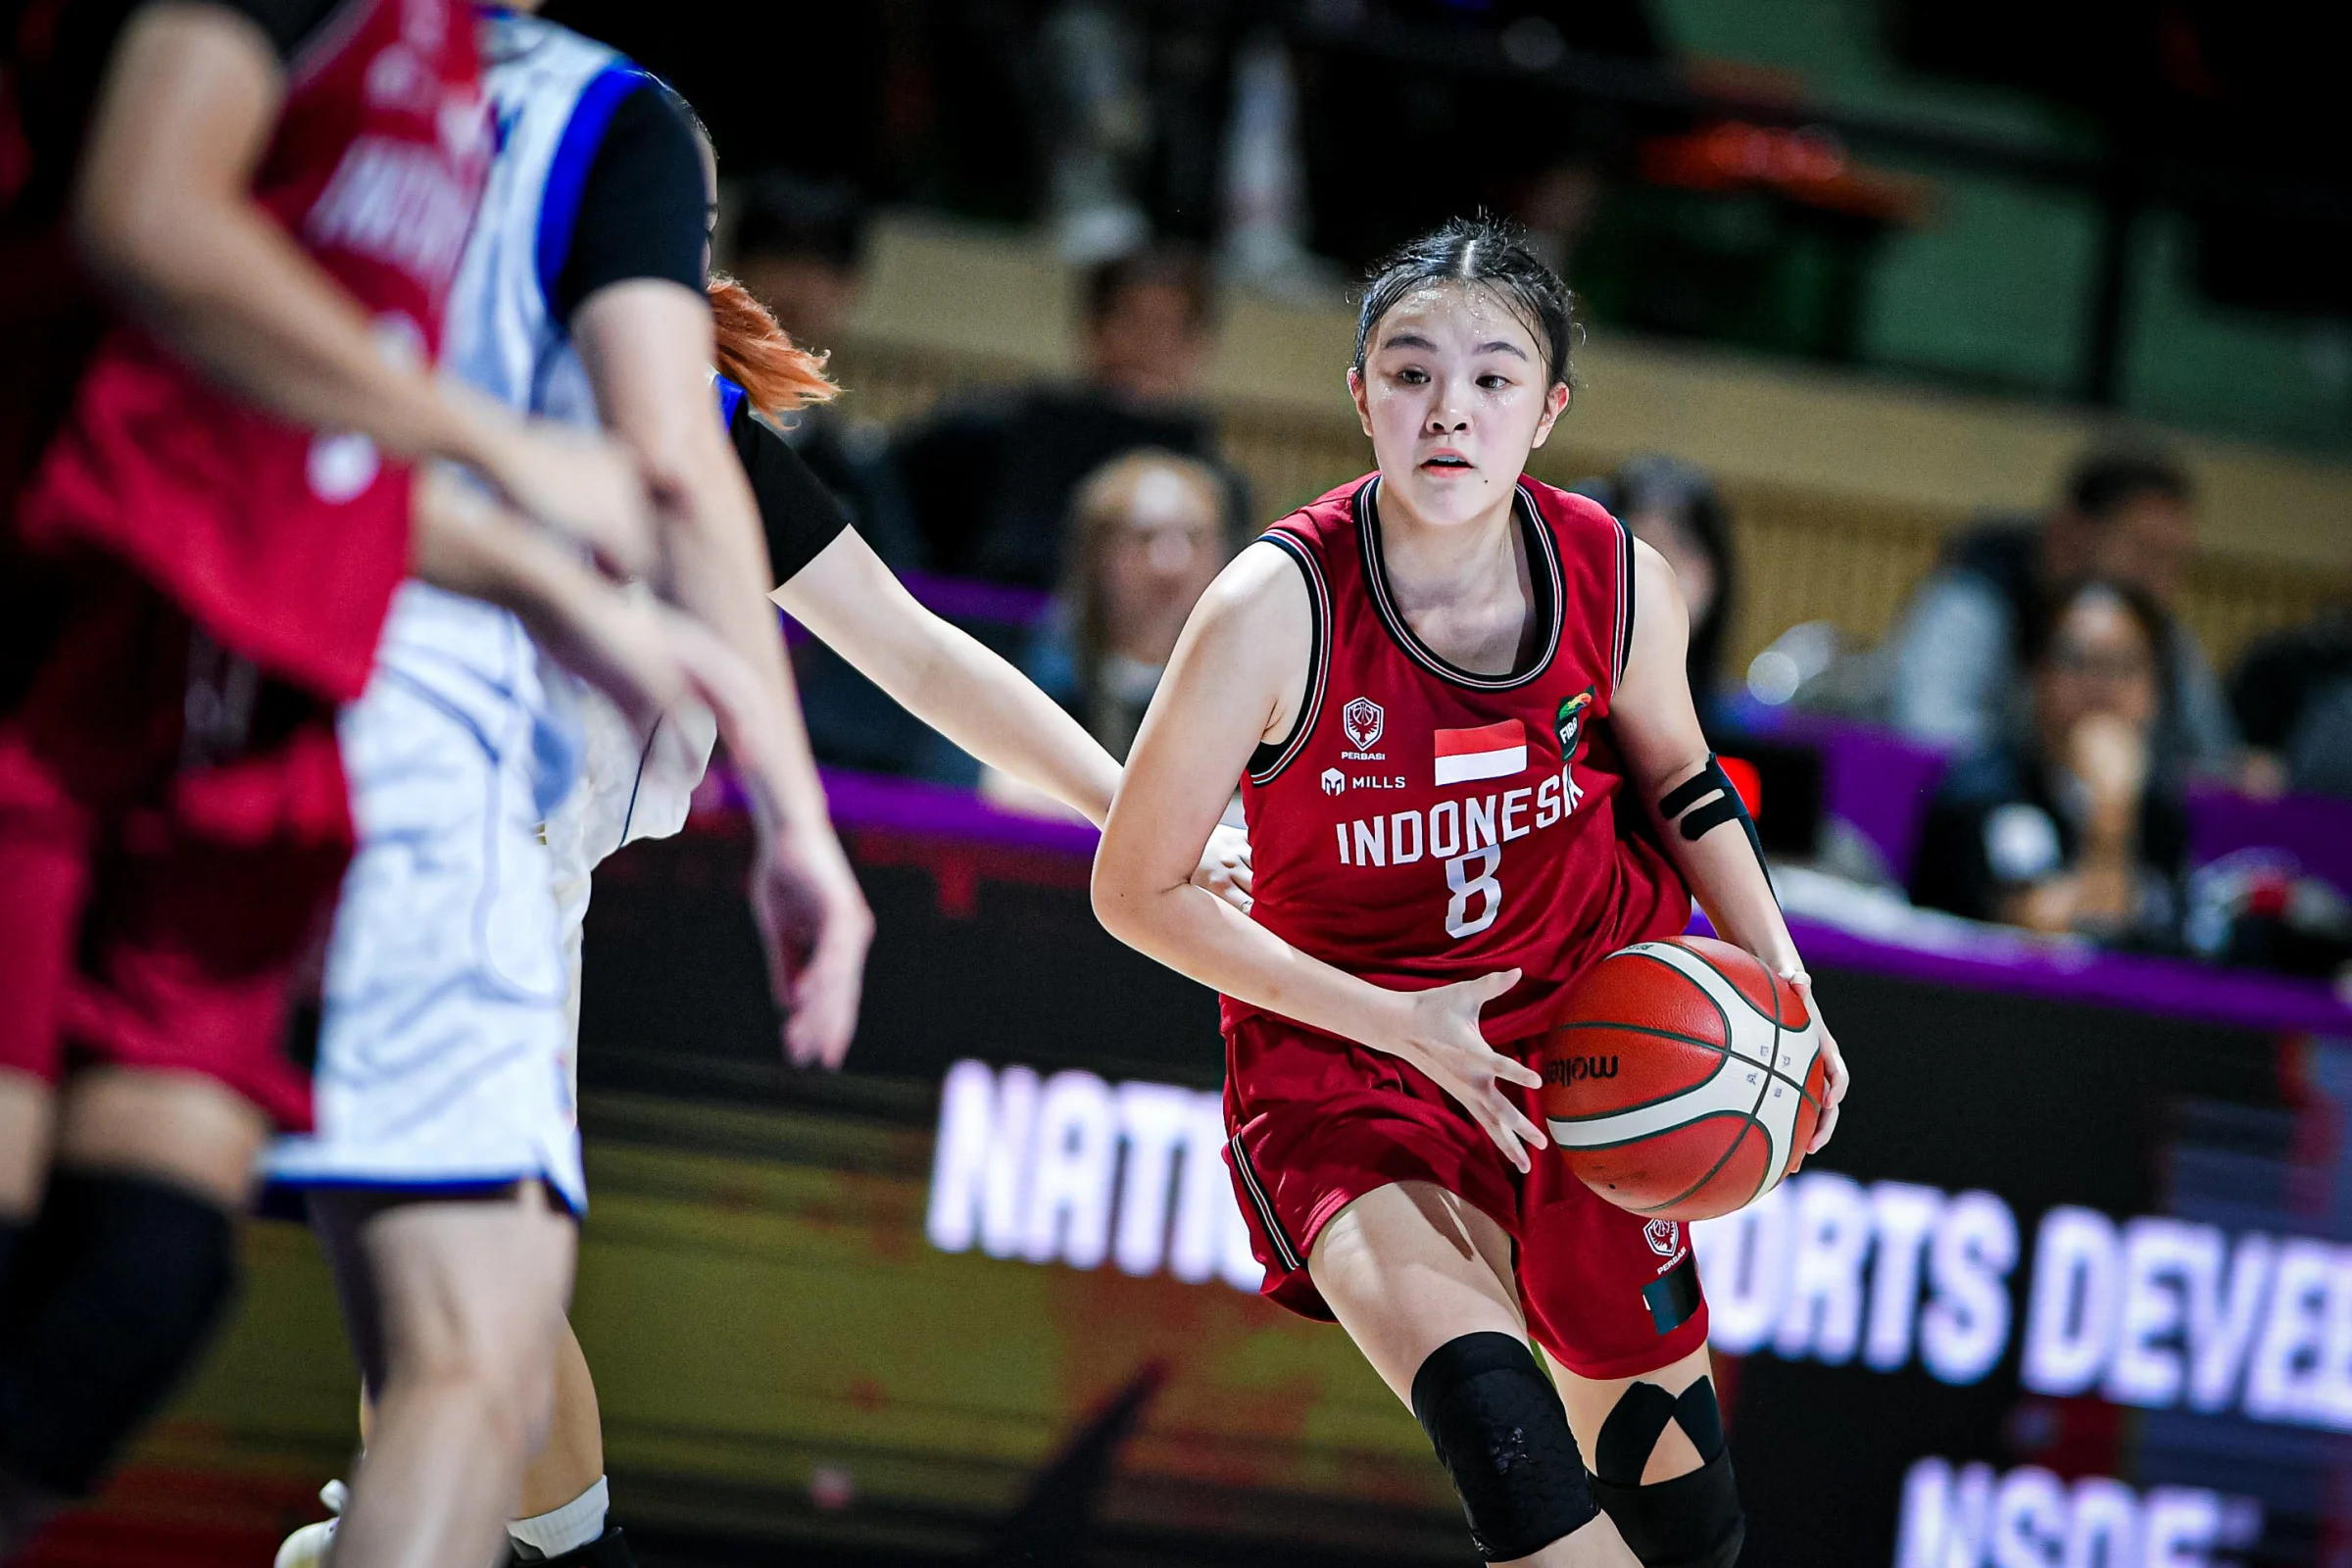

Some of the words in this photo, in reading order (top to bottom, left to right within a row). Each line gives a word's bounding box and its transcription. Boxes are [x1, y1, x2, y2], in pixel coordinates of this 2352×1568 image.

[1559, 717, 1578, 745] FIBA
[1341, 751, 1386, 760] PERBASI
[1352, 775, 1406, 789] MILLS
[1446, 843, 1502, 939] 8
